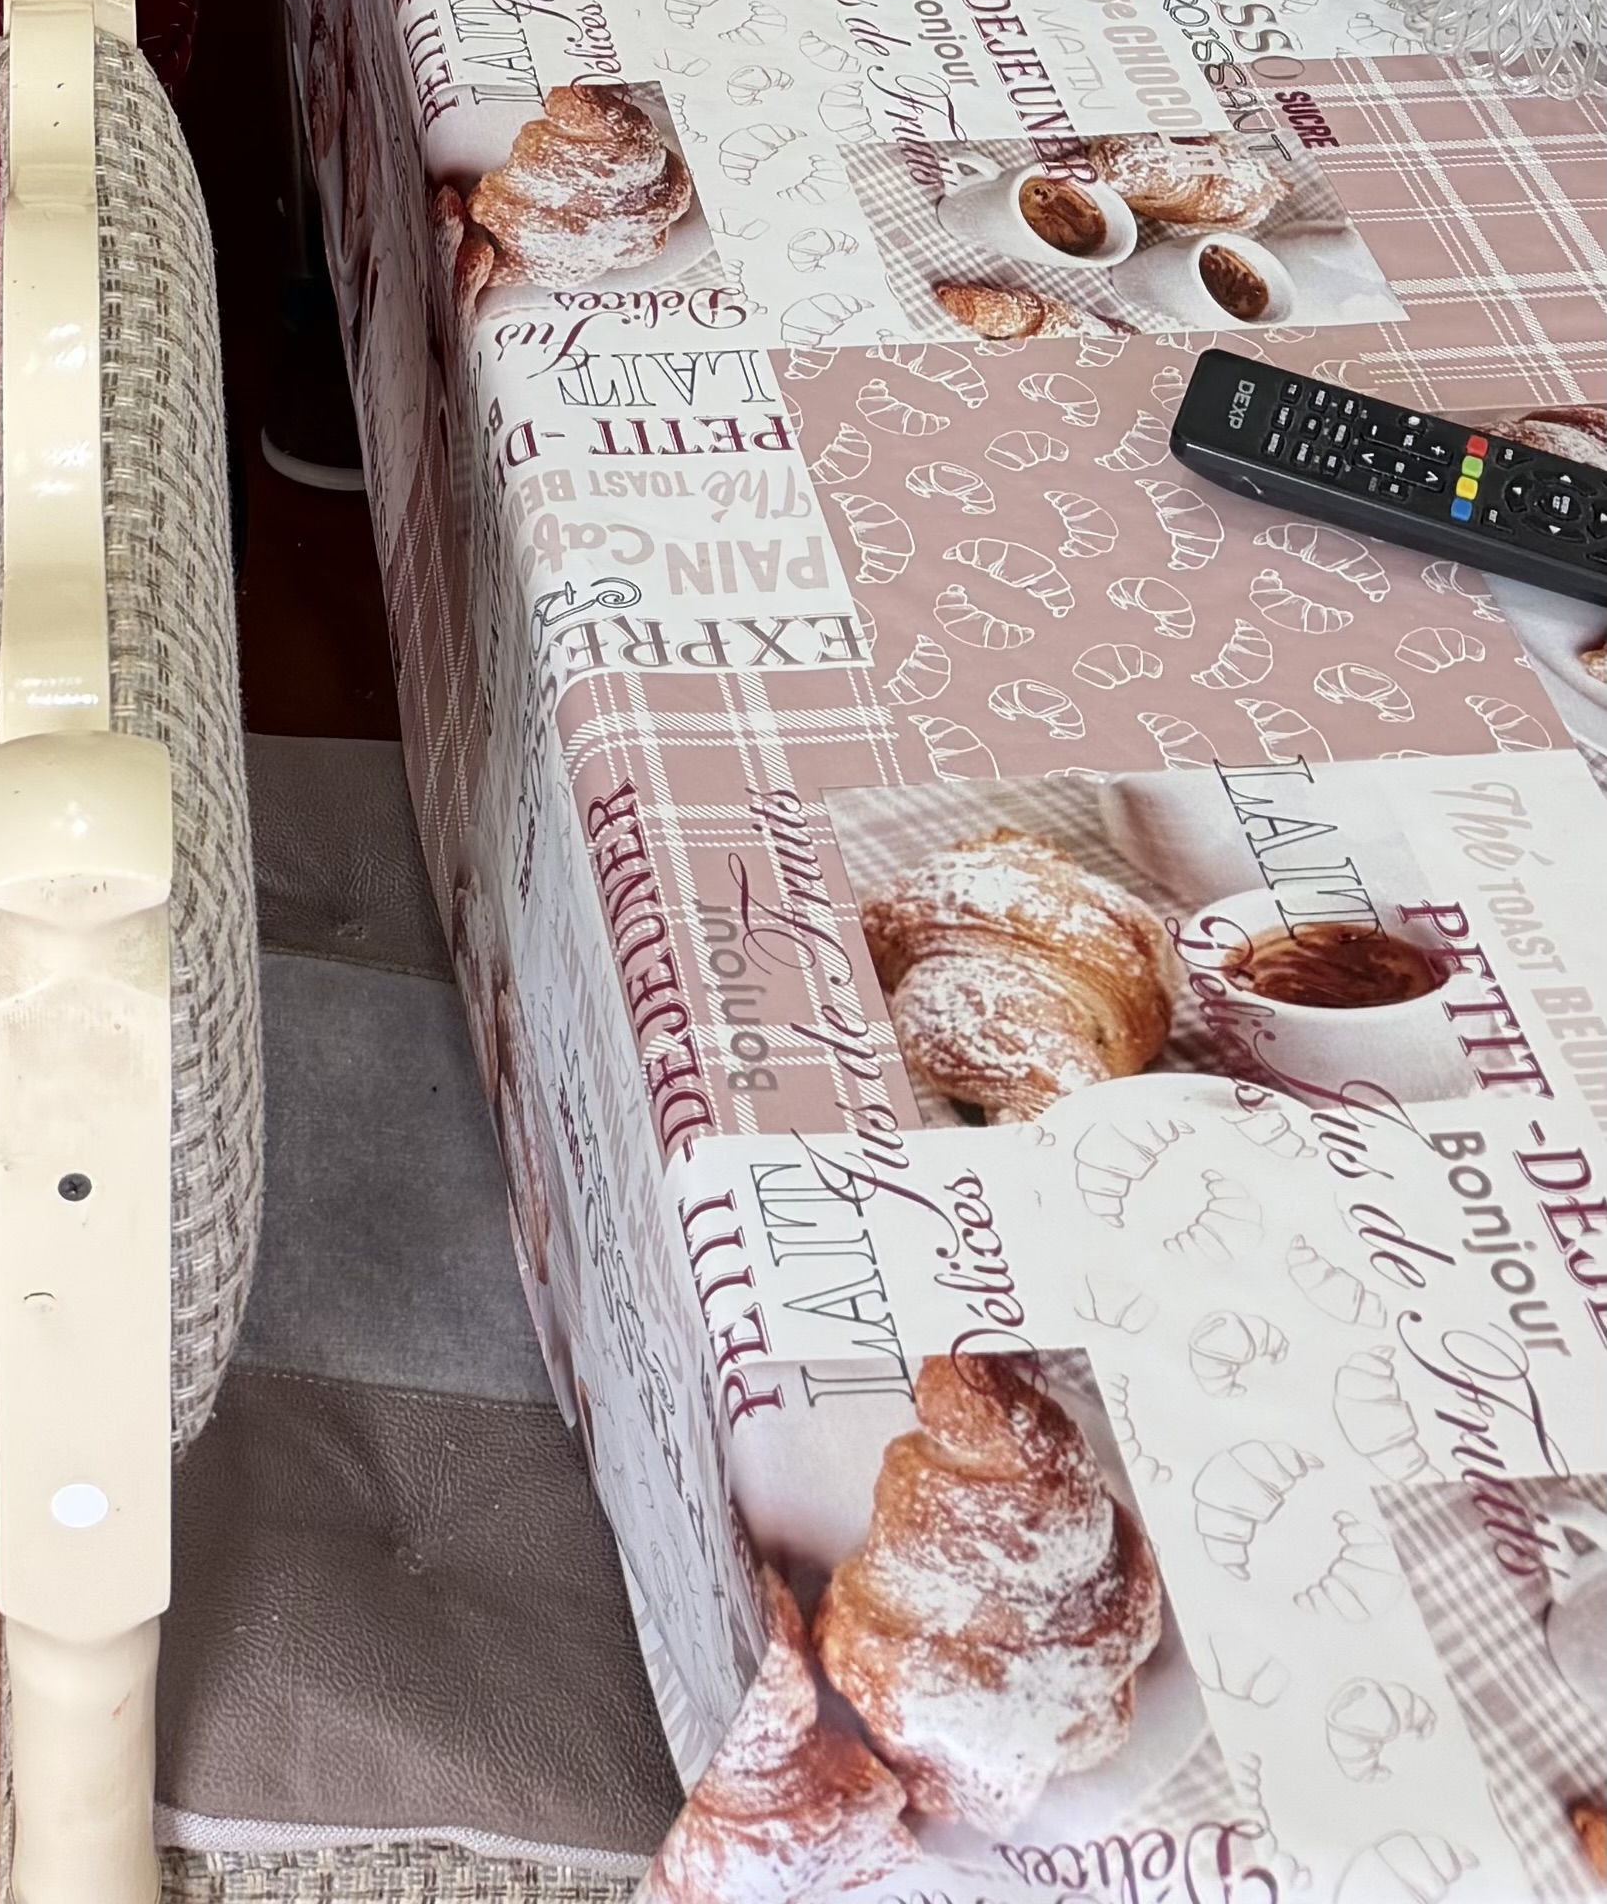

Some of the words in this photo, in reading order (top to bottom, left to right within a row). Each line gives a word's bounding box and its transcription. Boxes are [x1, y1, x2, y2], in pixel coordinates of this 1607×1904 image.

[844, 15, 912, 58] de
[1274, 90, 1341, 150] SUCRE
[552, 286, 747, 330] Délices
[557, 349, 776, 408] LAIT
[1227, 379, 1256, 430] DEXP
[588, 413, 795, 457] PETIT
[589, 468, 697, 499] TOAST
[702, 465, 812, 524] Thé
[665, 535, 830, 596] PAIN
[1213, 754, 1391, 944] LAIT
[1430, 780, 1555, 872] Thé
[728, 787, 854, 987] Fruits
[1477, 876, 1567, 974] TOAST
[695, 897, 778, 1093] Bonjour
[1395, 897, 1555, 1100] PETIT
[790, 1003, 884, 1082] de
[790, 1101, 961, 1260] Jus
[749, 1163, 917, 1408] LAIT
[934, 1167, 1050, 1395] Délices
[1348, 1202, 1457, 1291] de
[1428, 1129, 1573, 1358] Bonjour
[678, 1190, 784, 1429] PETIT
